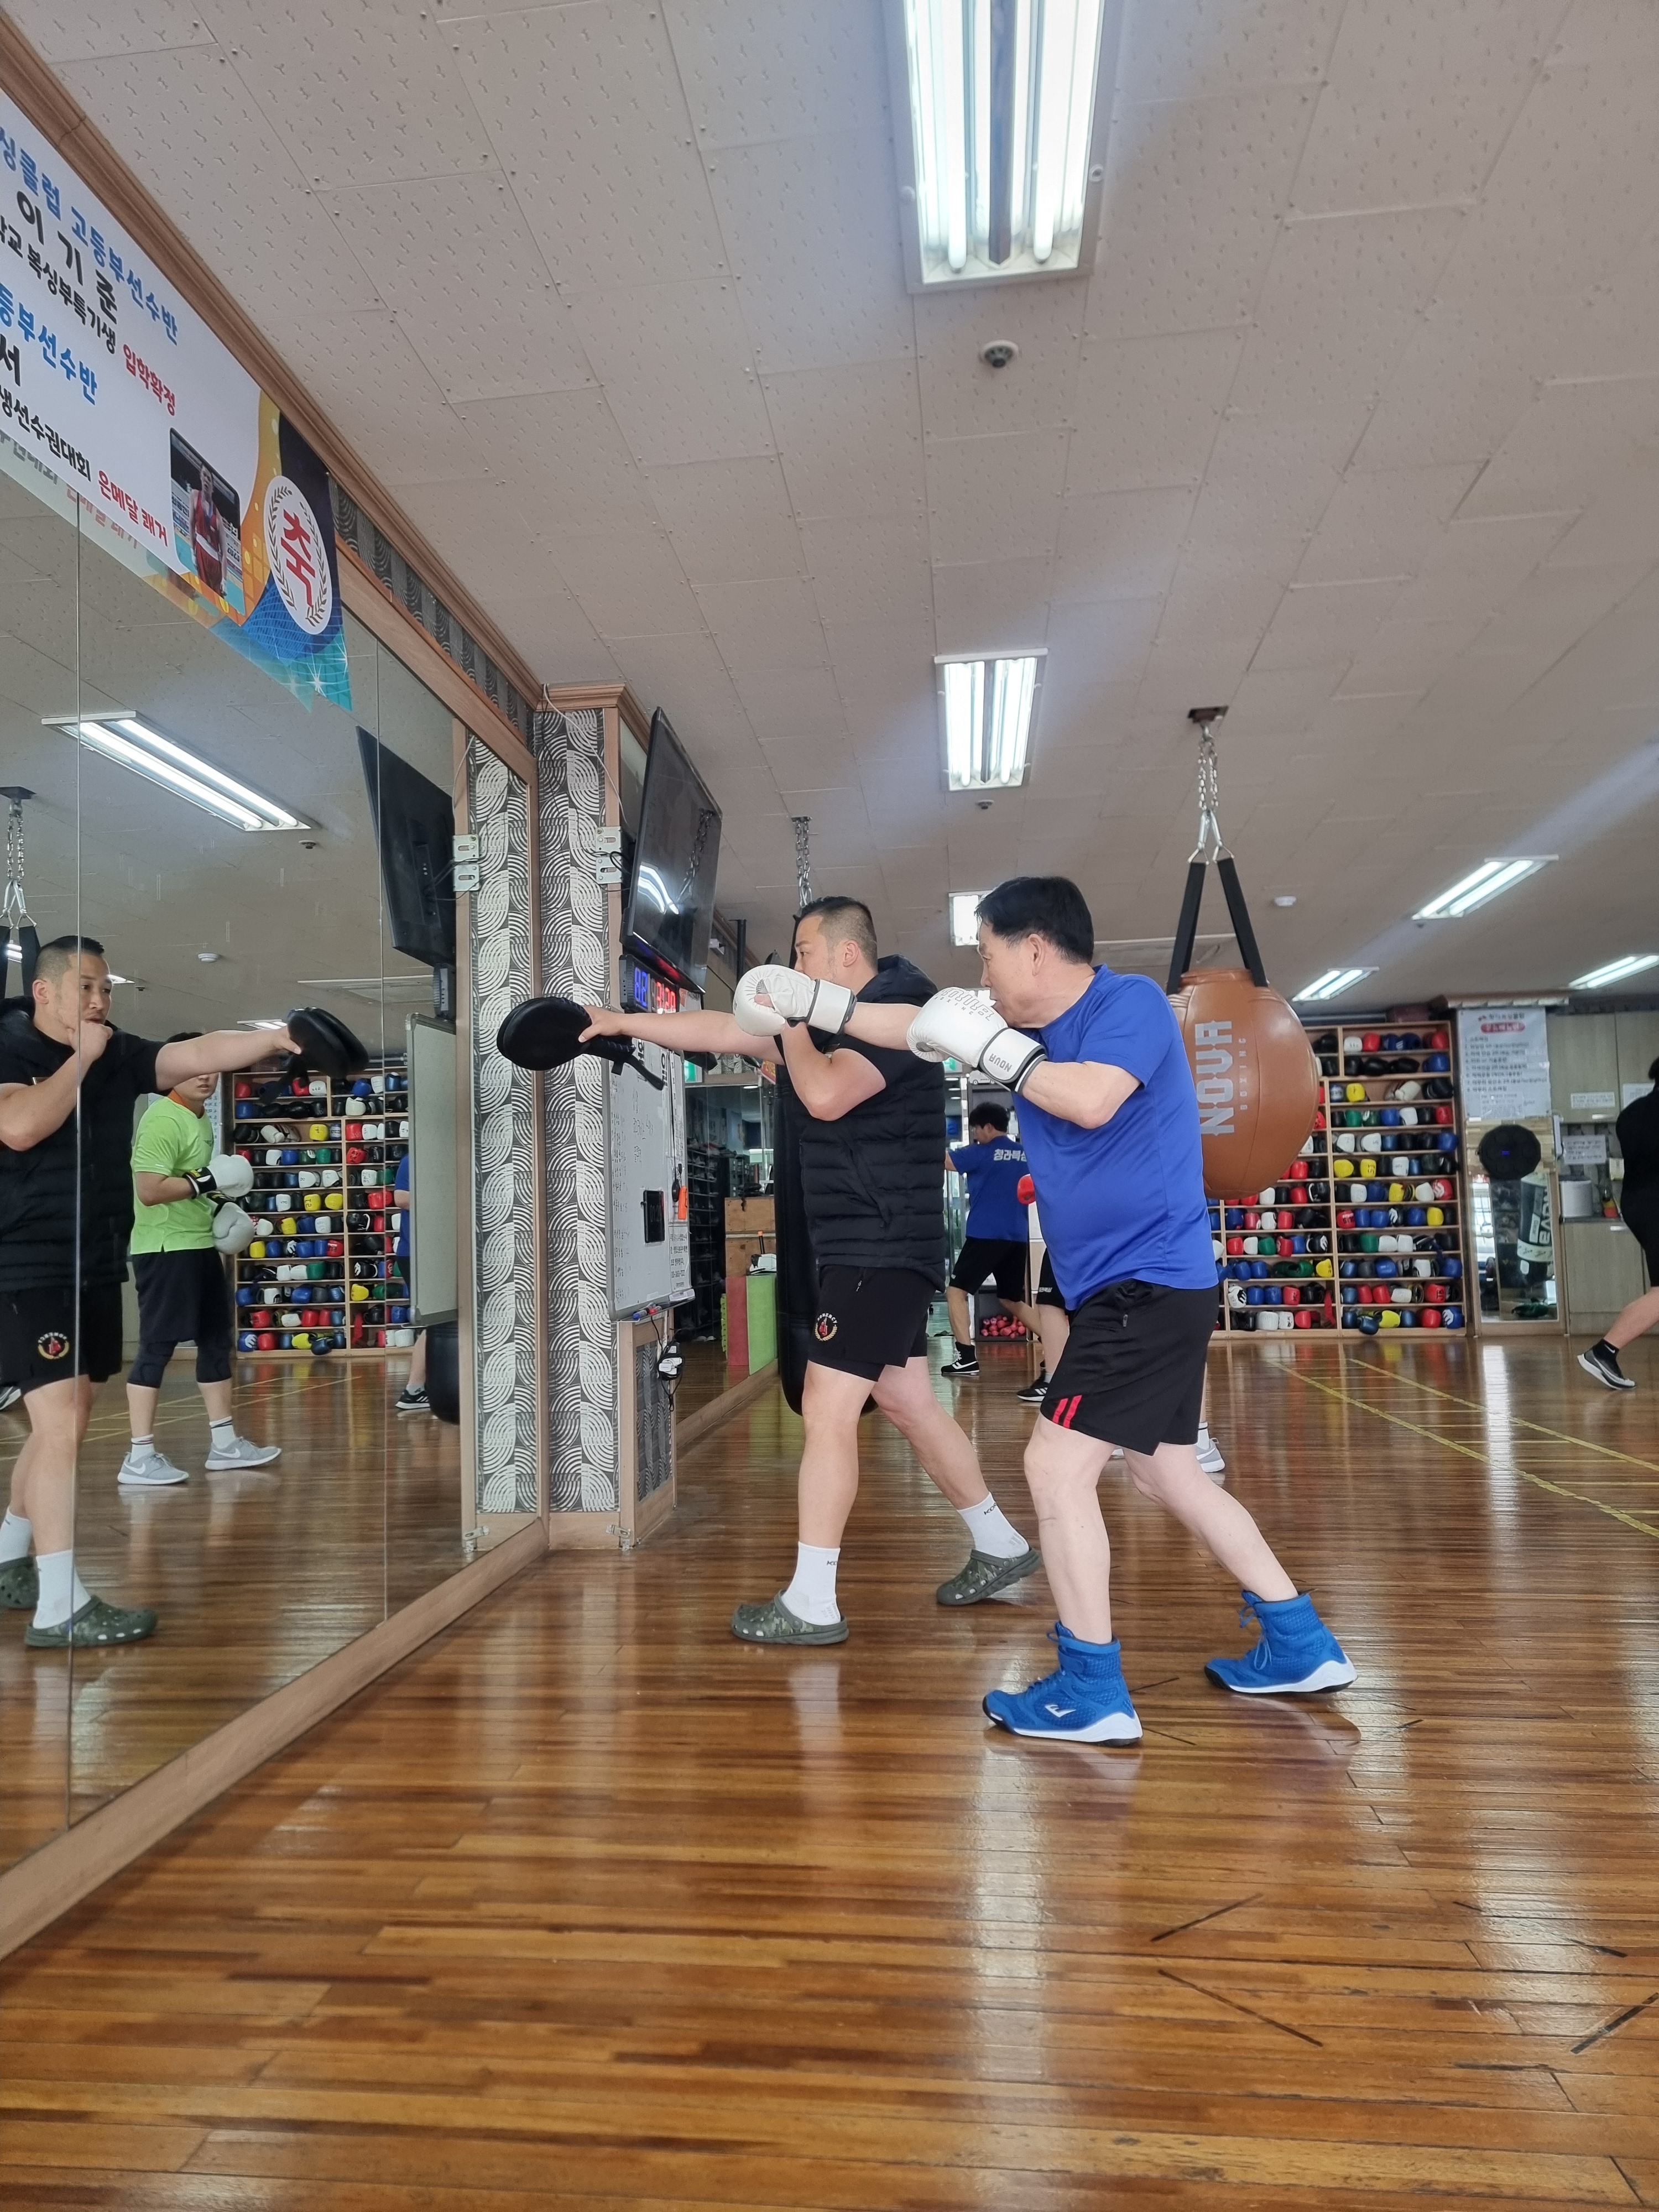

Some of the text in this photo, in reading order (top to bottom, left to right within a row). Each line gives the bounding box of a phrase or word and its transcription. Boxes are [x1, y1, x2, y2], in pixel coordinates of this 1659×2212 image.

[71, 205, 178, 346] 고등부선수반
[123, 343, 176, 416] 입학확정
[98, 470, 139, 525] 은메달
[141, 508, 168, 547] 쾌거
[989, 1053, 1013, 1072] NOVA
[1194, 1020, 1235, 1136] NOVA
[1238, 1037, 1248, 1110] BOXING
